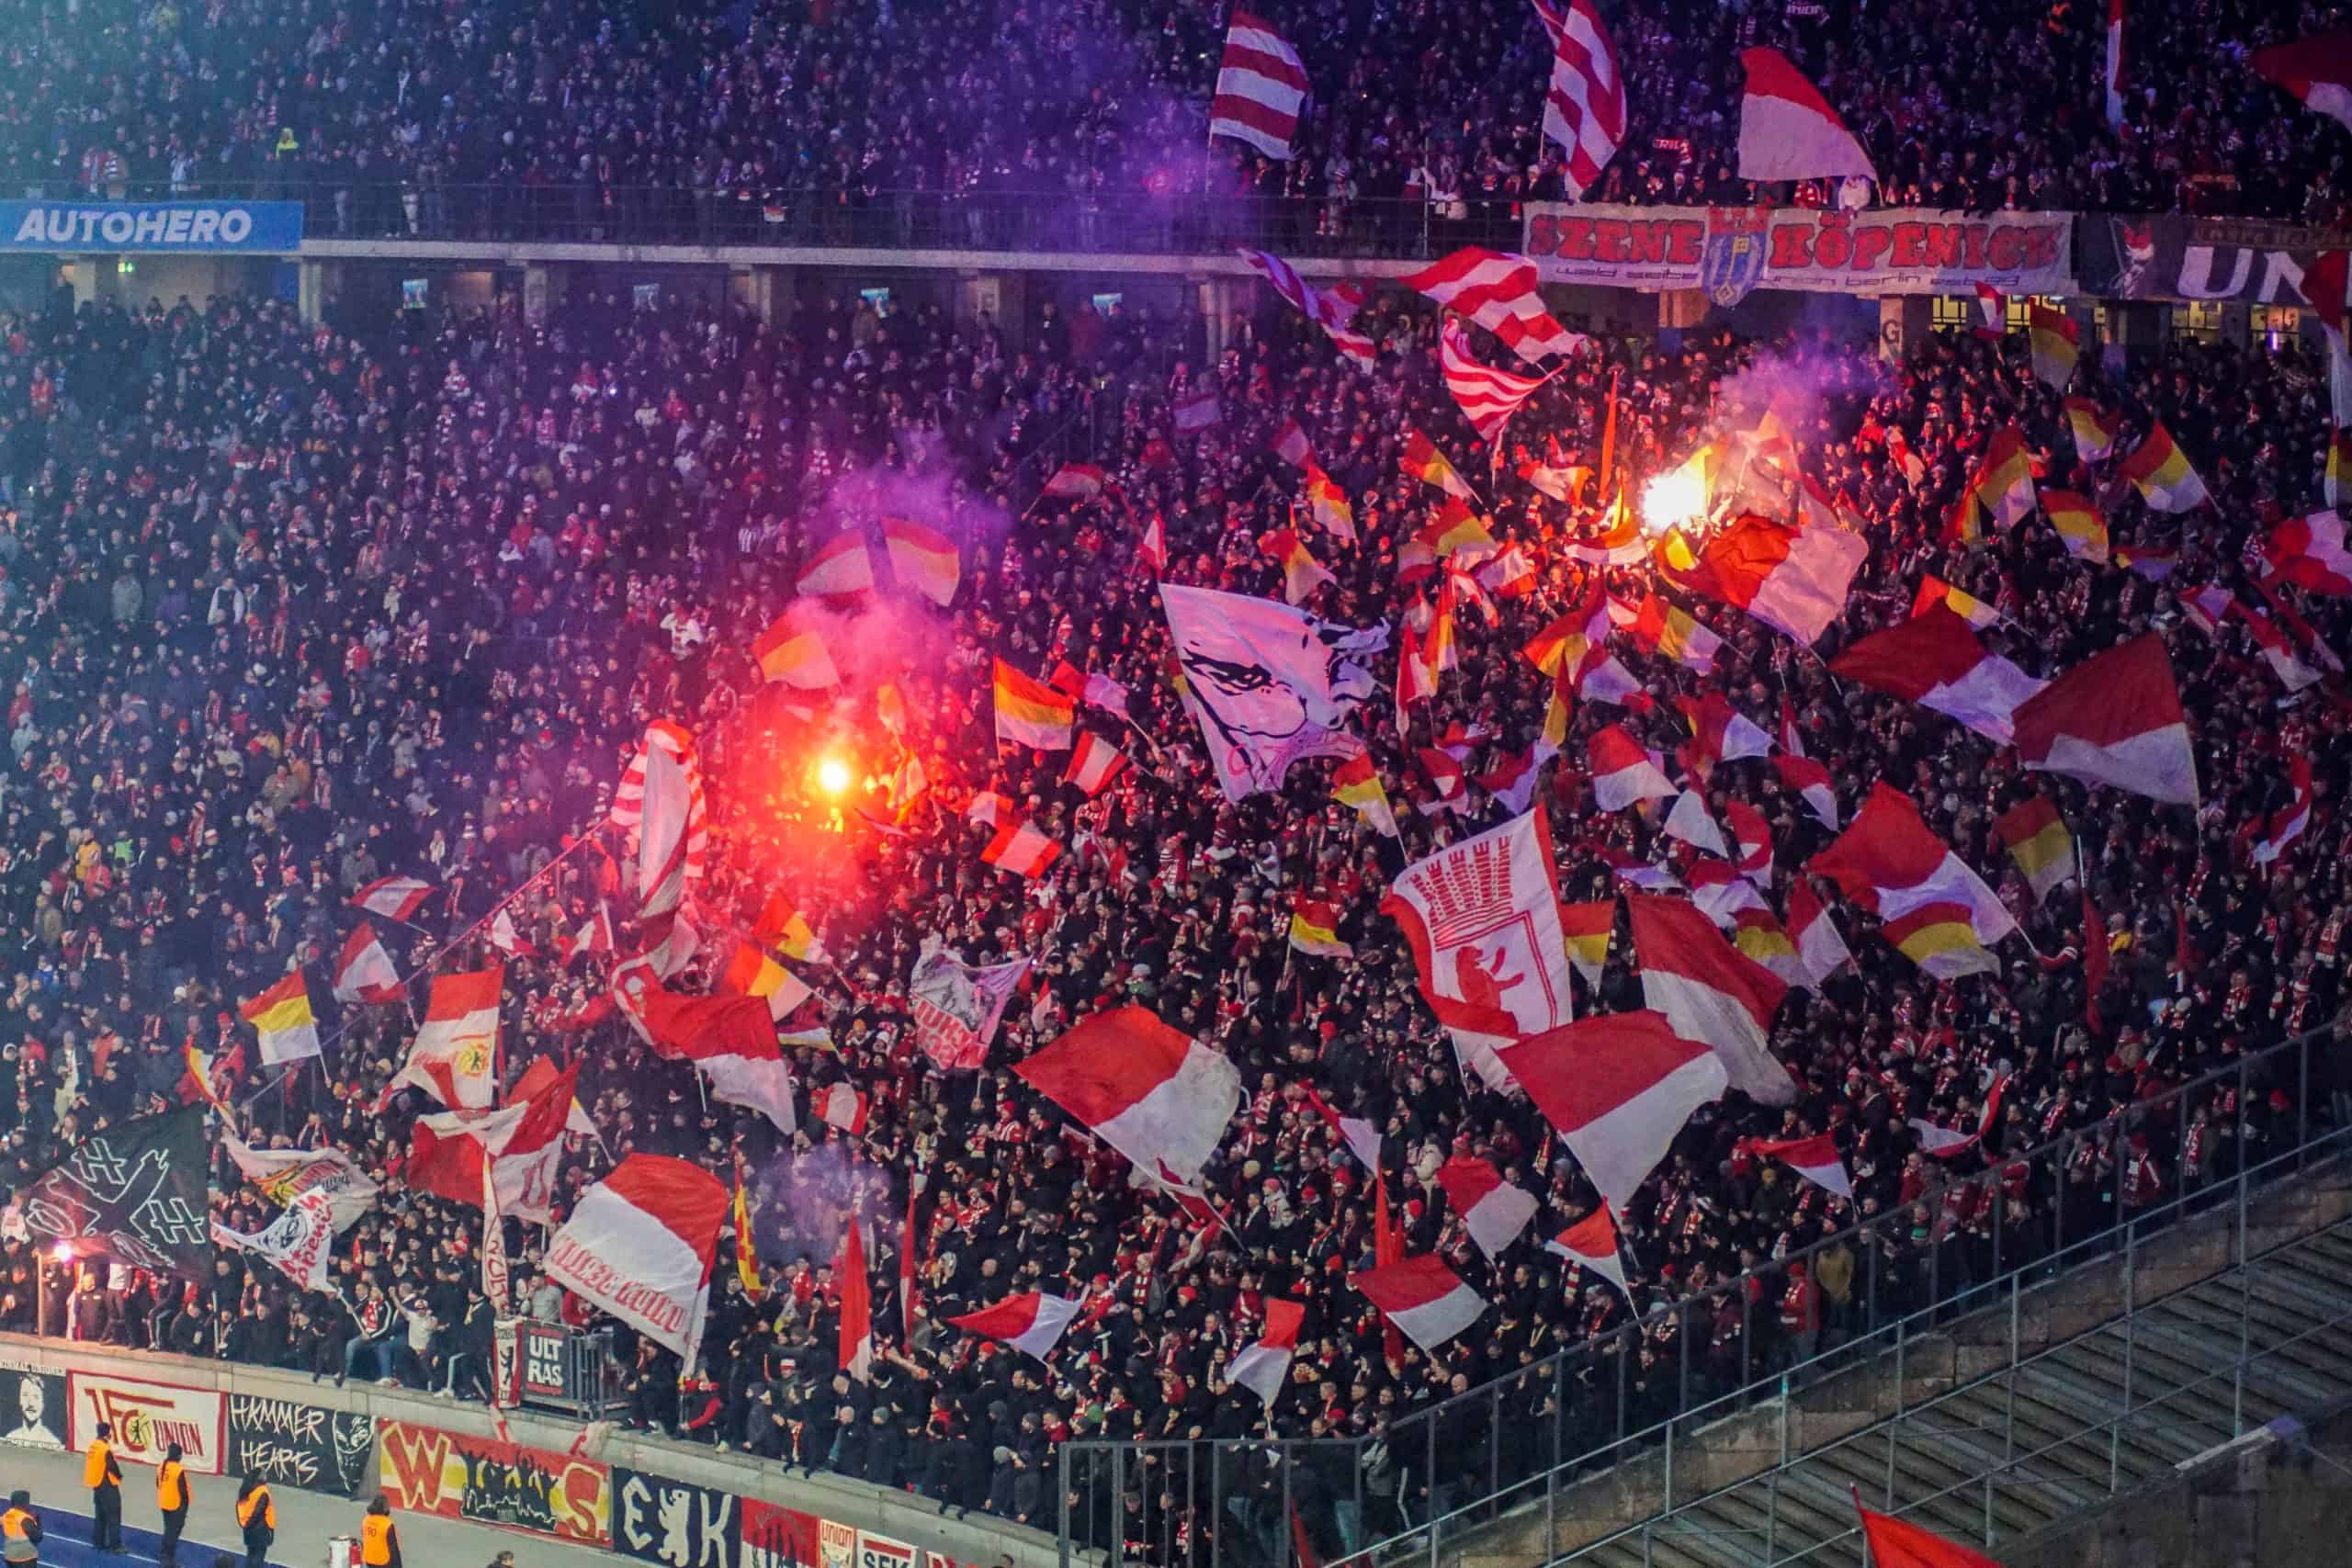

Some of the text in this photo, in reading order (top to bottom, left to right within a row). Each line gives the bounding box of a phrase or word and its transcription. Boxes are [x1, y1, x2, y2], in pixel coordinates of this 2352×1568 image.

[15, 209, 252, 243] AUTOHERO
[1528, 210, 2064, 271] SZENE KÖPENICK
[1845, 273, 1922, 287] berlin
[529, 1335, 564, 1362] ULT
[527, 1359, 564, 1388] RAS
[153, 1418, 204, 1457] UNION
[241, 1438, 320, 1487] HEARTS
